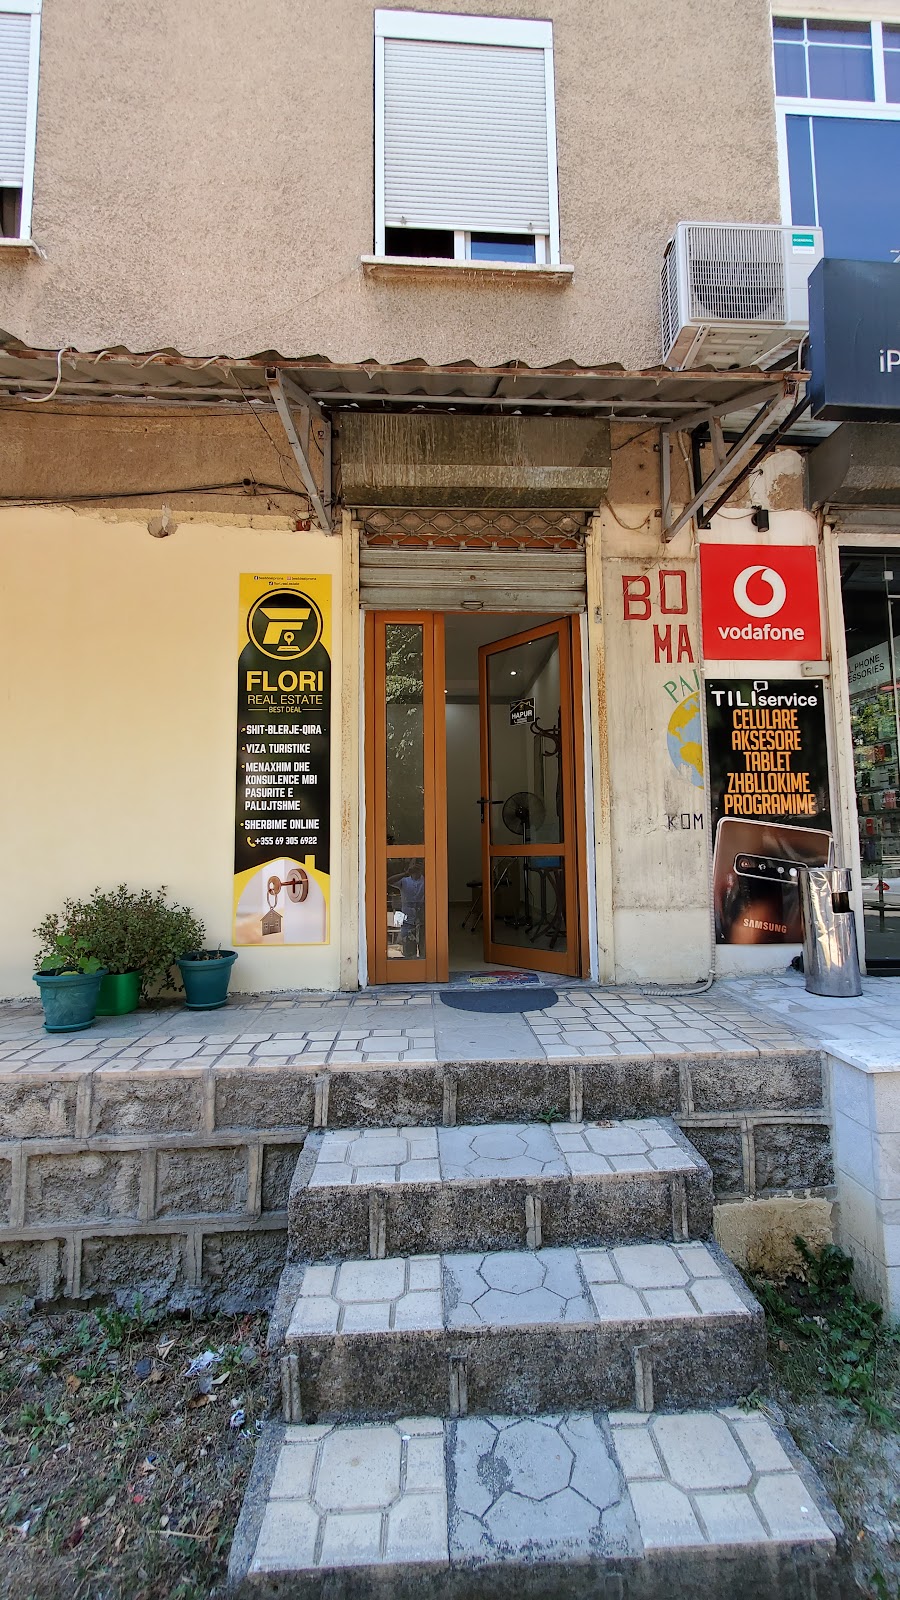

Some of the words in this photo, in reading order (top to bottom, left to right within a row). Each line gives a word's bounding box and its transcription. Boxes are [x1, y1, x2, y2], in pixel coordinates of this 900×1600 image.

[717, 623, 805, 641] vodafone
[854, 653, 880, 671] PHONE
[246, 670, 324, 692] FLORI
[247, 695, 277, 705] REAL
[280, 695, 323, 705] ESTATE
[511, 709, 533, 720] HAPUR
[732, 709, 799, 730] CELULARE
[246, 724, 322, 736] SHIT-BLERJE-QIRA
[731, 730, 802, 751] AKSESORE
[246, 743, 266, 754] VIZA
[269, 743, 311, 754] TURISTIKE
[245, 762, 291, 772] MENAXHIM
[293, 761, 310, 772] DHE
[743, 751, 791, 772] TABLET
[245, 774, 300, 785] KONSULENCE
[301, 774, 318, 785] MBI
[726, 772, 811, 793] ZHBLLOKIME
[245, 787, 285, 798] PASURITE
[287, 787, 293, 798] E
[244, 800, 301, 811] PALUJTSHME
[724, 794, 817, 815] PROGRAMIME
[244, 819, 288, 830] SHERBIME
[289, 818, 320, 830] ONLINE
[667, 813, 704, 830] KOM
[254, 837, 274, 845] +355
[275, 836, 284, 845] 69
[285, 836, 298, 845] 305
[299, 836, 318, 845] 6922
[743, 918, 787, 934] SAMSUNG
